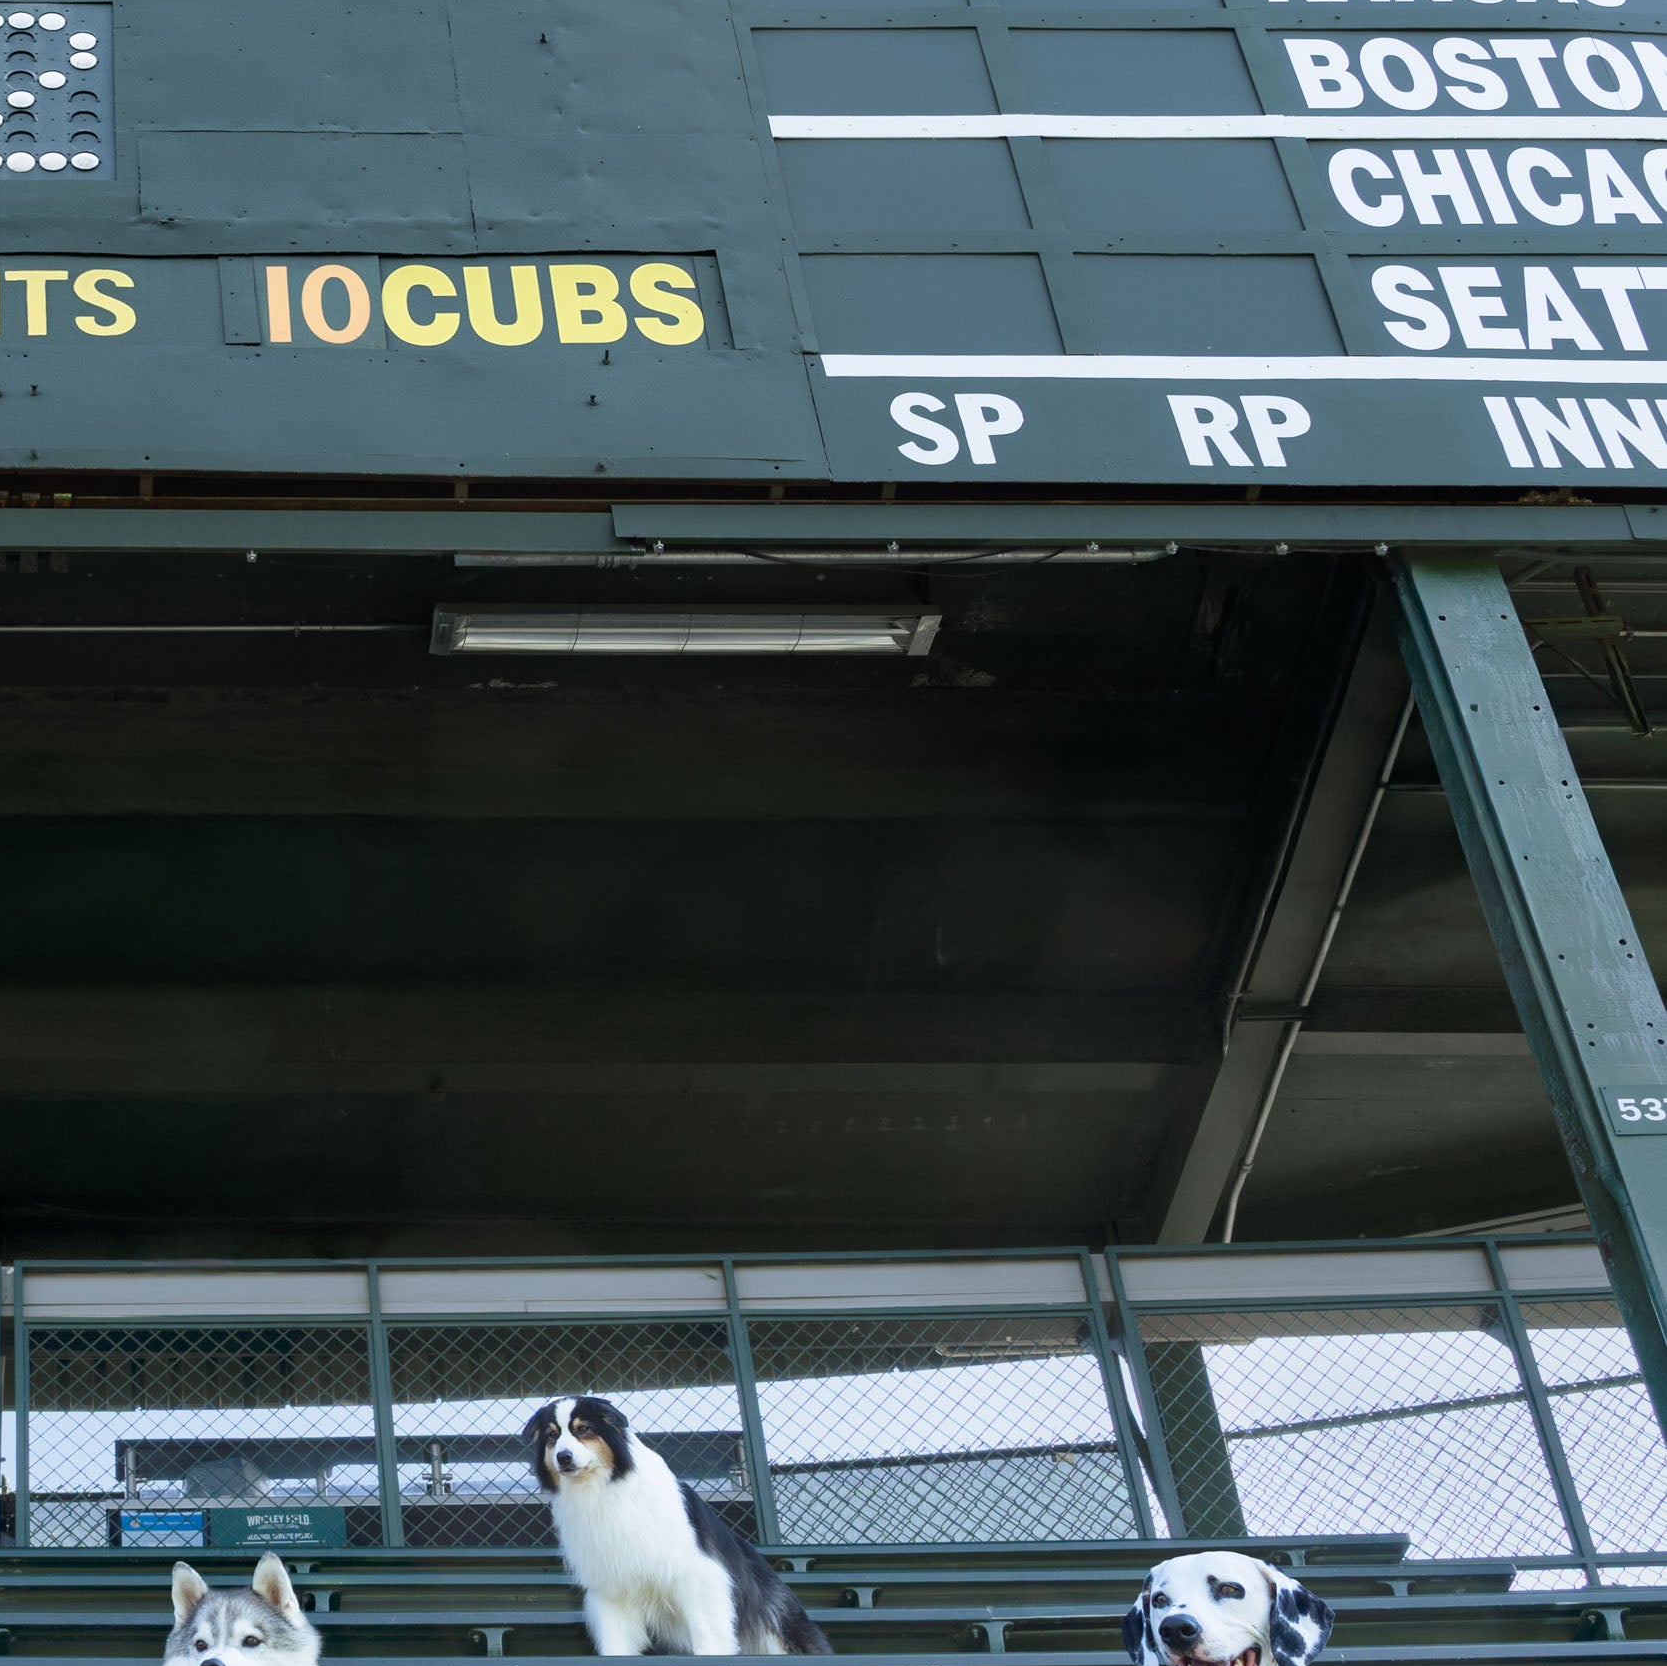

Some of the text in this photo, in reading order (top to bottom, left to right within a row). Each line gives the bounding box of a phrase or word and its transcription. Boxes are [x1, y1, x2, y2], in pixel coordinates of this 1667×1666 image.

[382, 263, 704, 346] CUBS
[890, 393, 1667, 470] SP RP INN
[1617, 1097, 1667, 1122] 53
